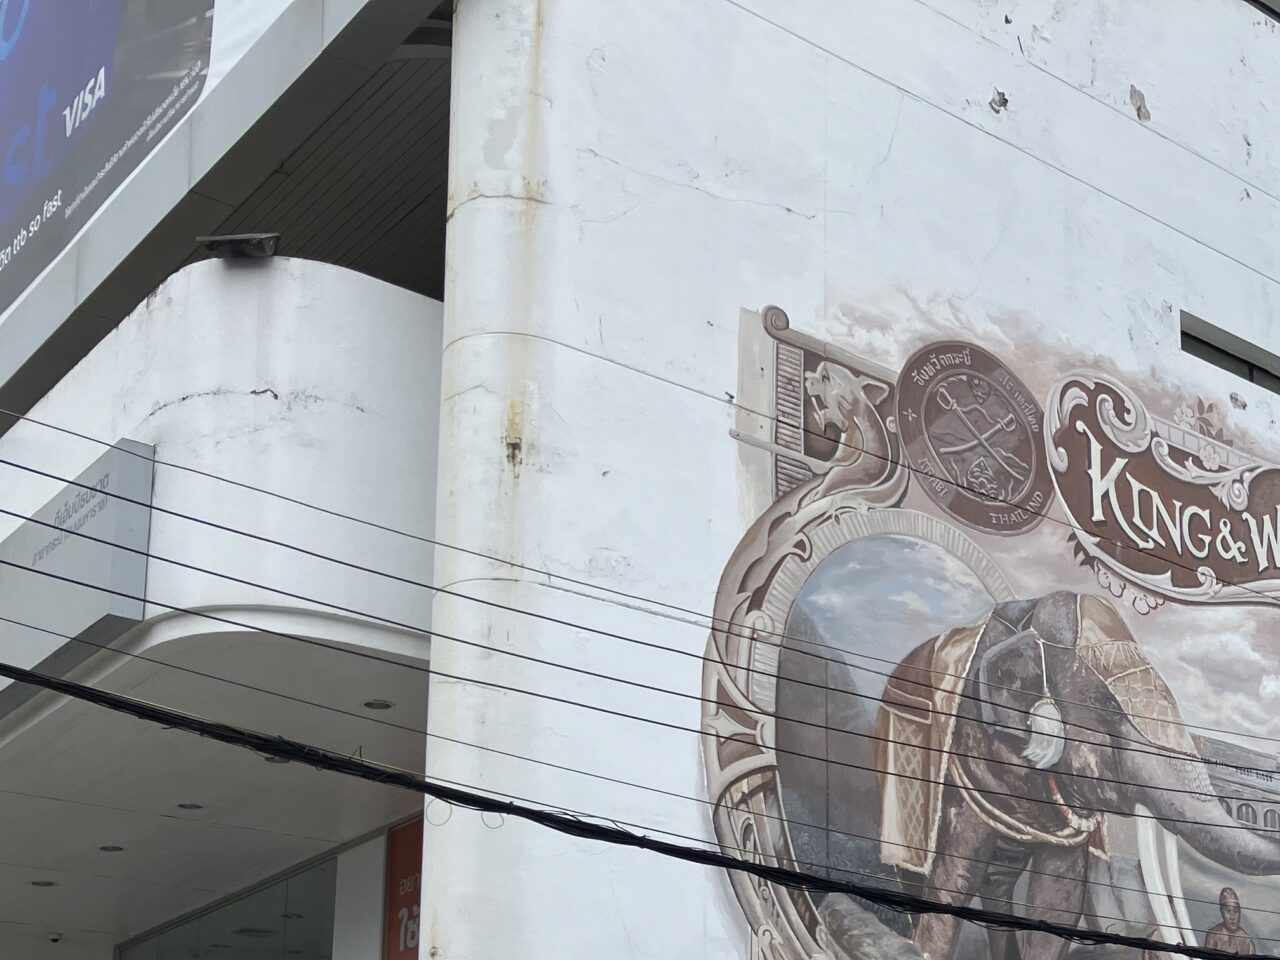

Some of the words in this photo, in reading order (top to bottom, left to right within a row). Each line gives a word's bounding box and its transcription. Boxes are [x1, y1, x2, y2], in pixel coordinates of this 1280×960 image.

[62, 66, 105, 137] VISA
[13, 228, 27, 254] ttb
[29, 215, 41, 236] so
[43, 189, 62, 222] fast
[918, 457, 949, 498] KRABI
[988, 491, 1043, 525] THAILAND
[1075, 420, 1211, 560] KING
[1215, 519, 1248, 564] &
